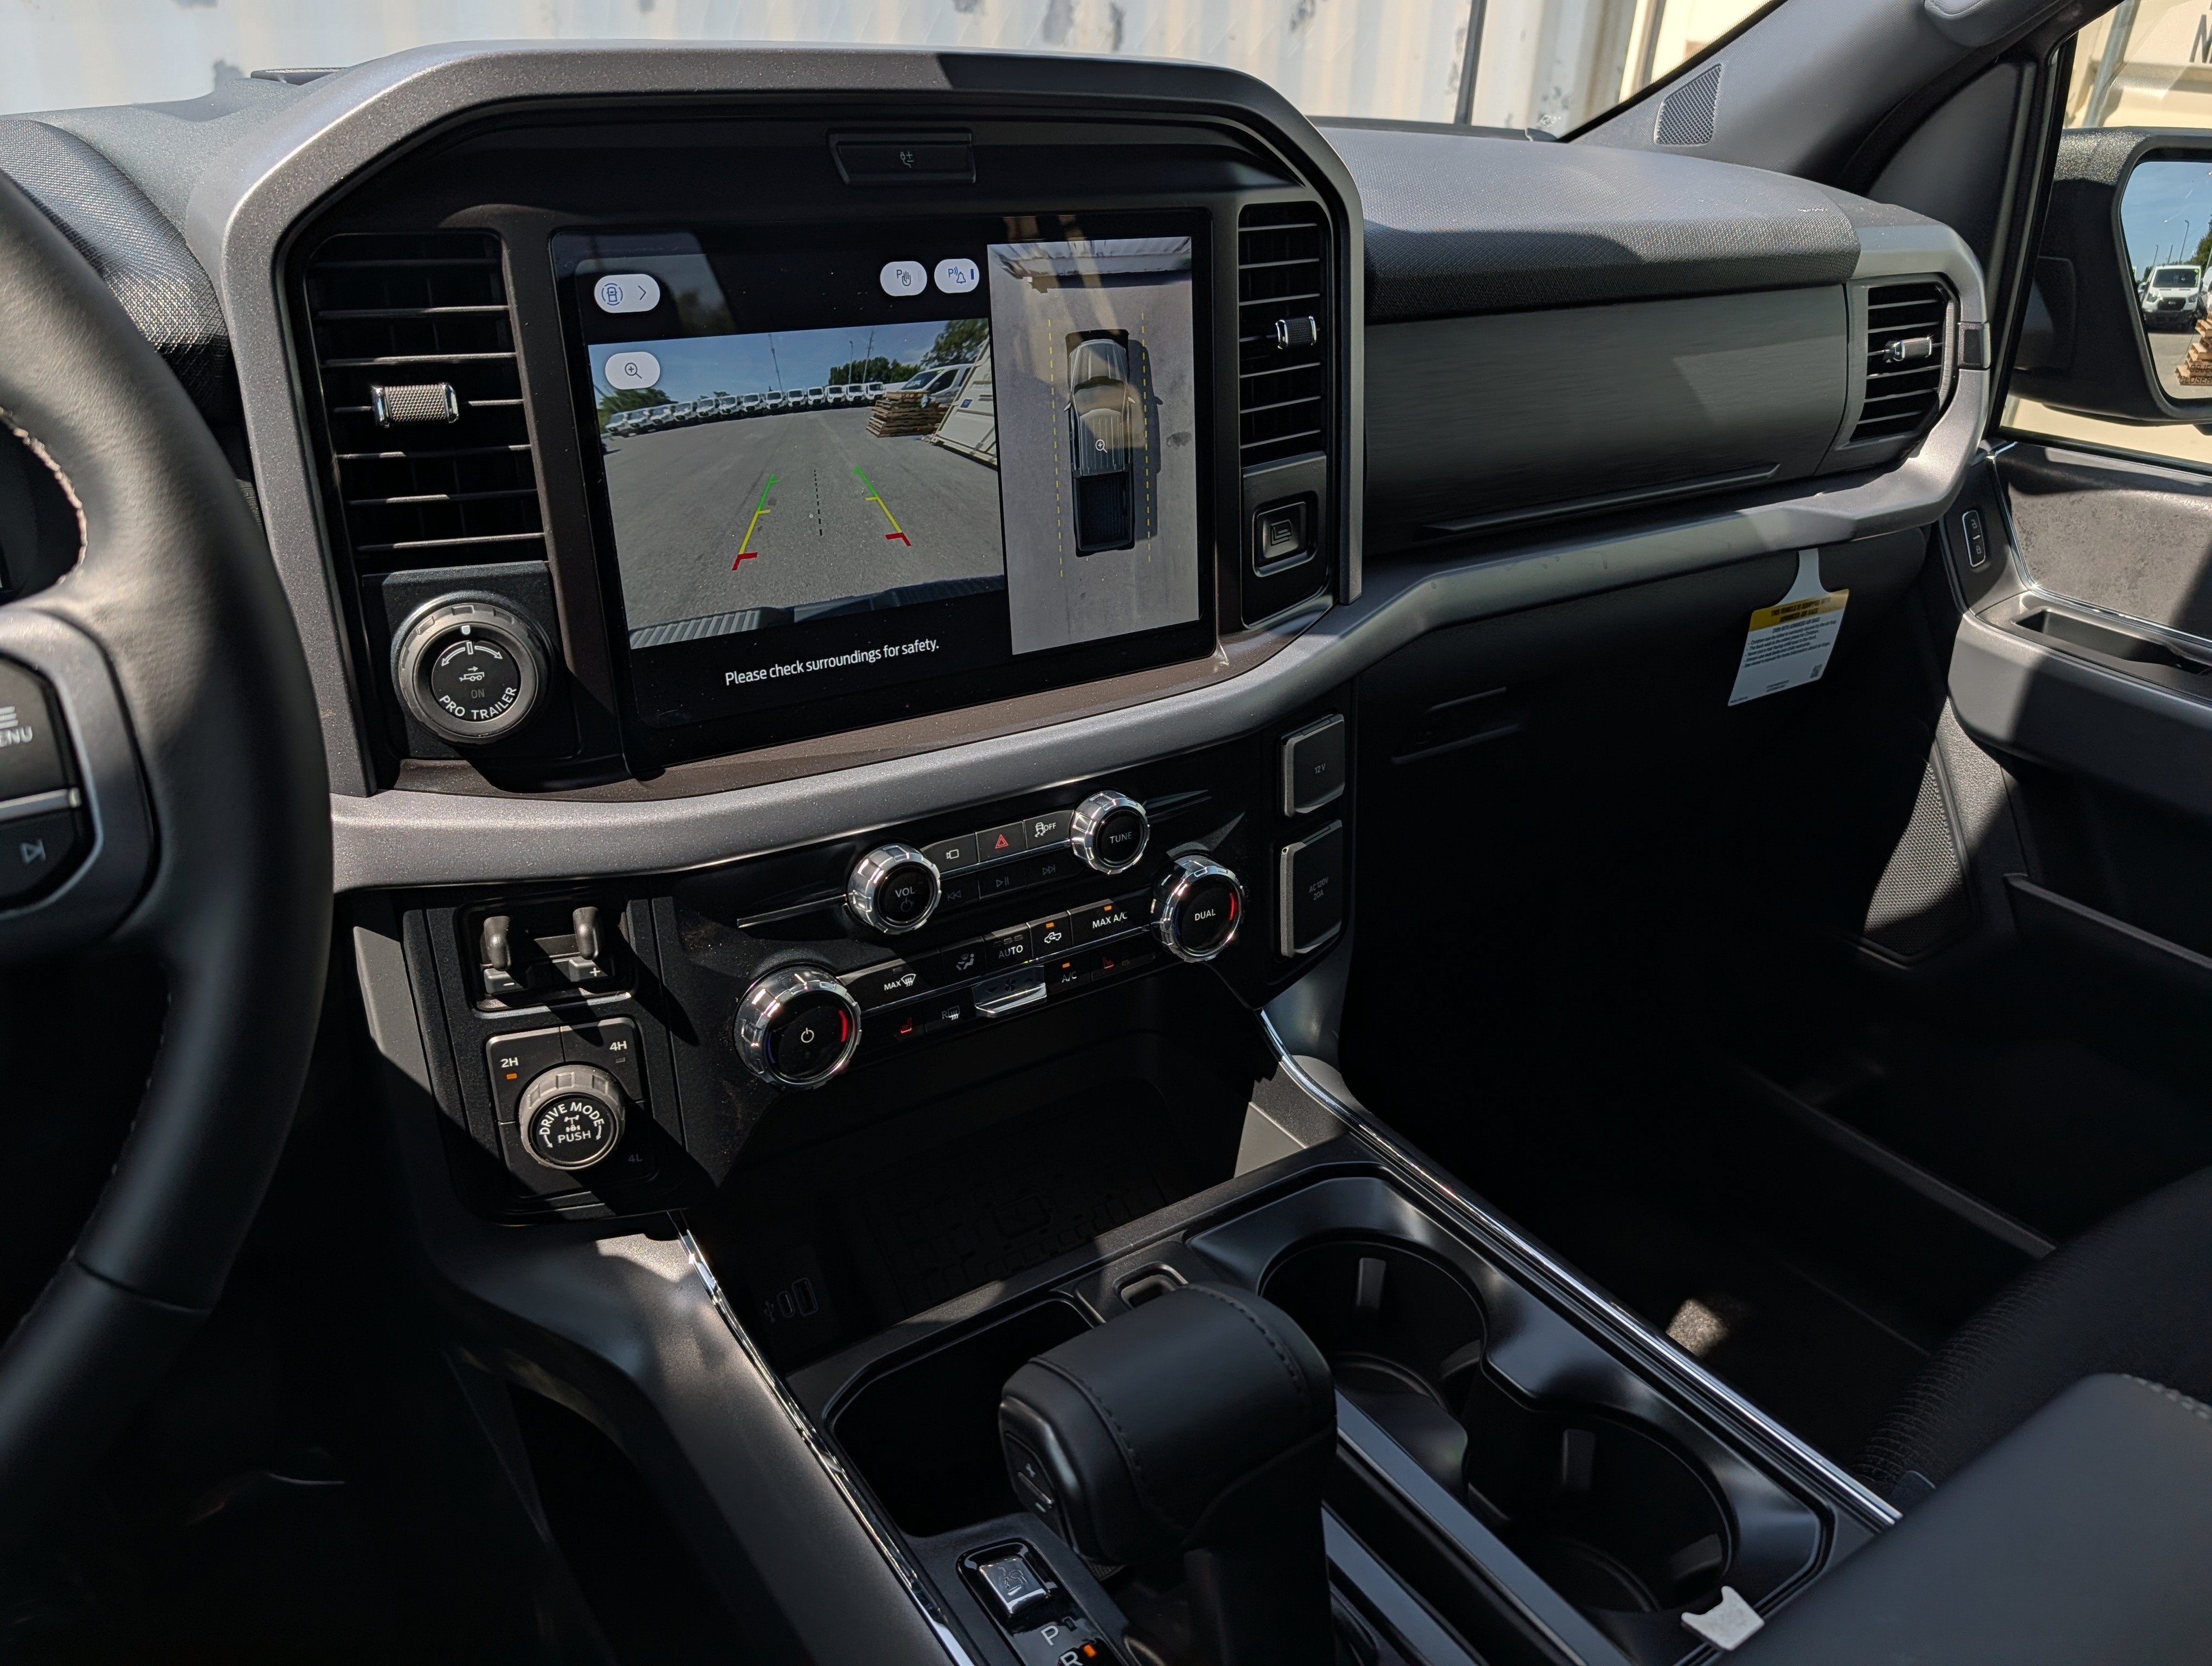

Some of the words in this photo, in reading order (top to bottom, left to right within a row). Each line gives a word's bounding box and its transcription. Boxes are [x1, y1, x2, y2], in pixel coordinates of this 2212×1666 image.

[725, 669, 768, 686] Please
[769, 660, 805, 678] check
[806, 650, 882, 671] surroundings
[883, 645, 900, 658] for
[901, 638, 940, 656] safety.
[471, 688, 485, 699] ON
[439, 695, 465, 717] PRO
[470, 687, 518, 720] TRAILER
[1044, 822, 1056, 831] OFF
[1109, 831, 1132, 844] TUNE
[895, 886, 915, 898] VOL
[1092, 915, 1111, 929] MAX
[1113, 911, 1128, 922] A/C
[1194, 908, 1216, 921] DUAL
[998, 945, 1023, 959] AUTO
[1062, 971, 1077, 983] A/C
[884, 980, 902, 991] MAX
[942, 1010, 949, 1020] R
[609, 1040, 627, 1051] 4H
[500, 1057, 519, 1068] 2H
[539, 1103, 568, 1135] DRIVE
[569, 1101, 605, 1127] MODE
[557, 1130, 591, 1144] PUSH
[628, 1154, 643, 1163] 4L
[1040, 1625, 1059, 1646] P
[1060, 1651, 1083, 1666] R
